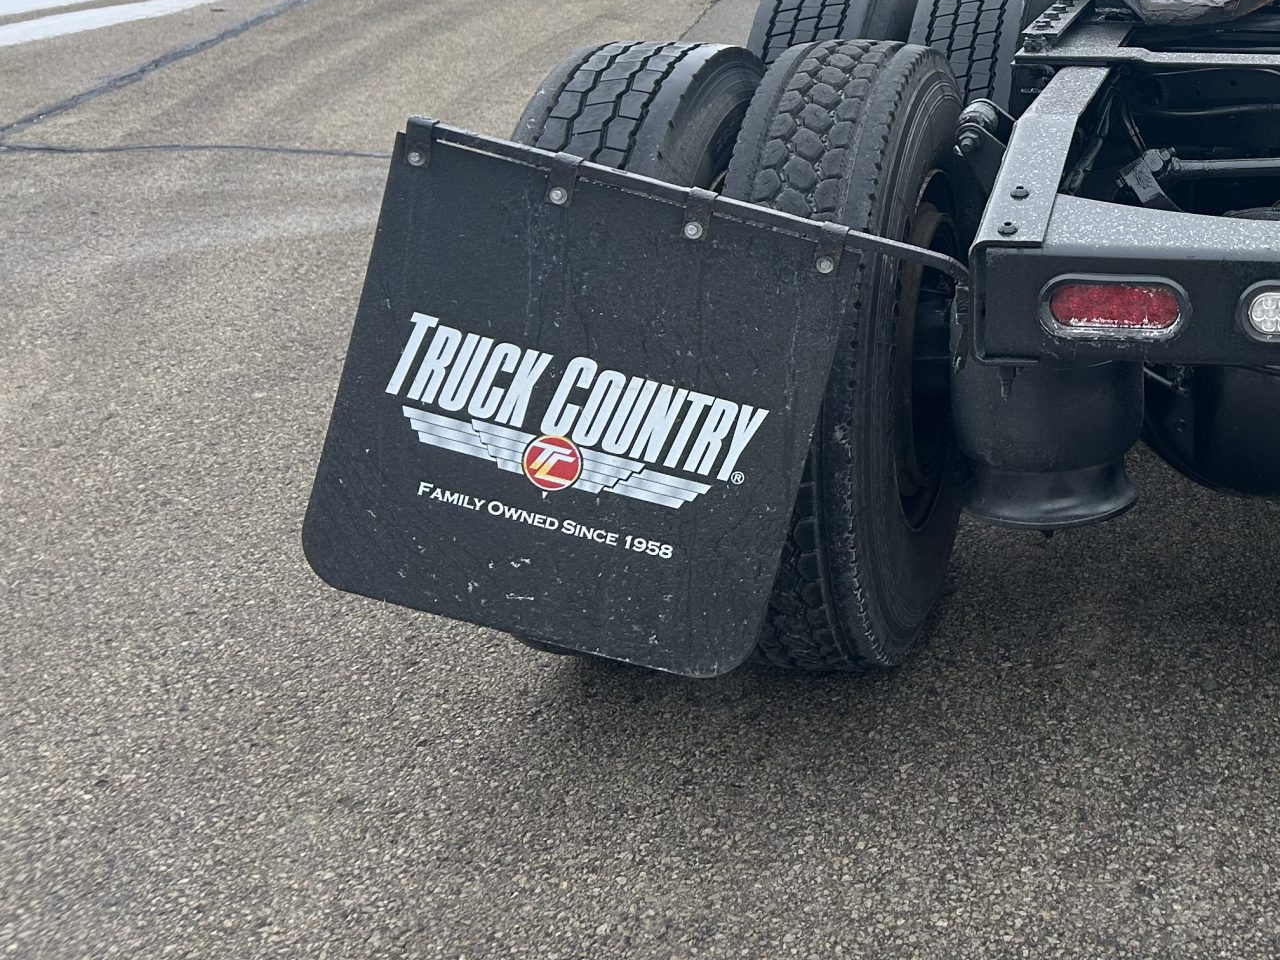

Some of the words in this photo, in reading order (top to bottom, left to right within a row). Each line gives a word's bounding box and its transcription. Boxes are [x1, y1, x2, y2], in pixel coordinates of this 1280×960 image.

[385, 311, 553, 428] TRUCK
[540, 356, 769, 482] COUNTRY
[416, 481, 486, 511] FAMILY
[487, 500, 560, 531] OWNED
[561, 519, 618, 547] SINCE
[624, 535, 674, 559] 1958
